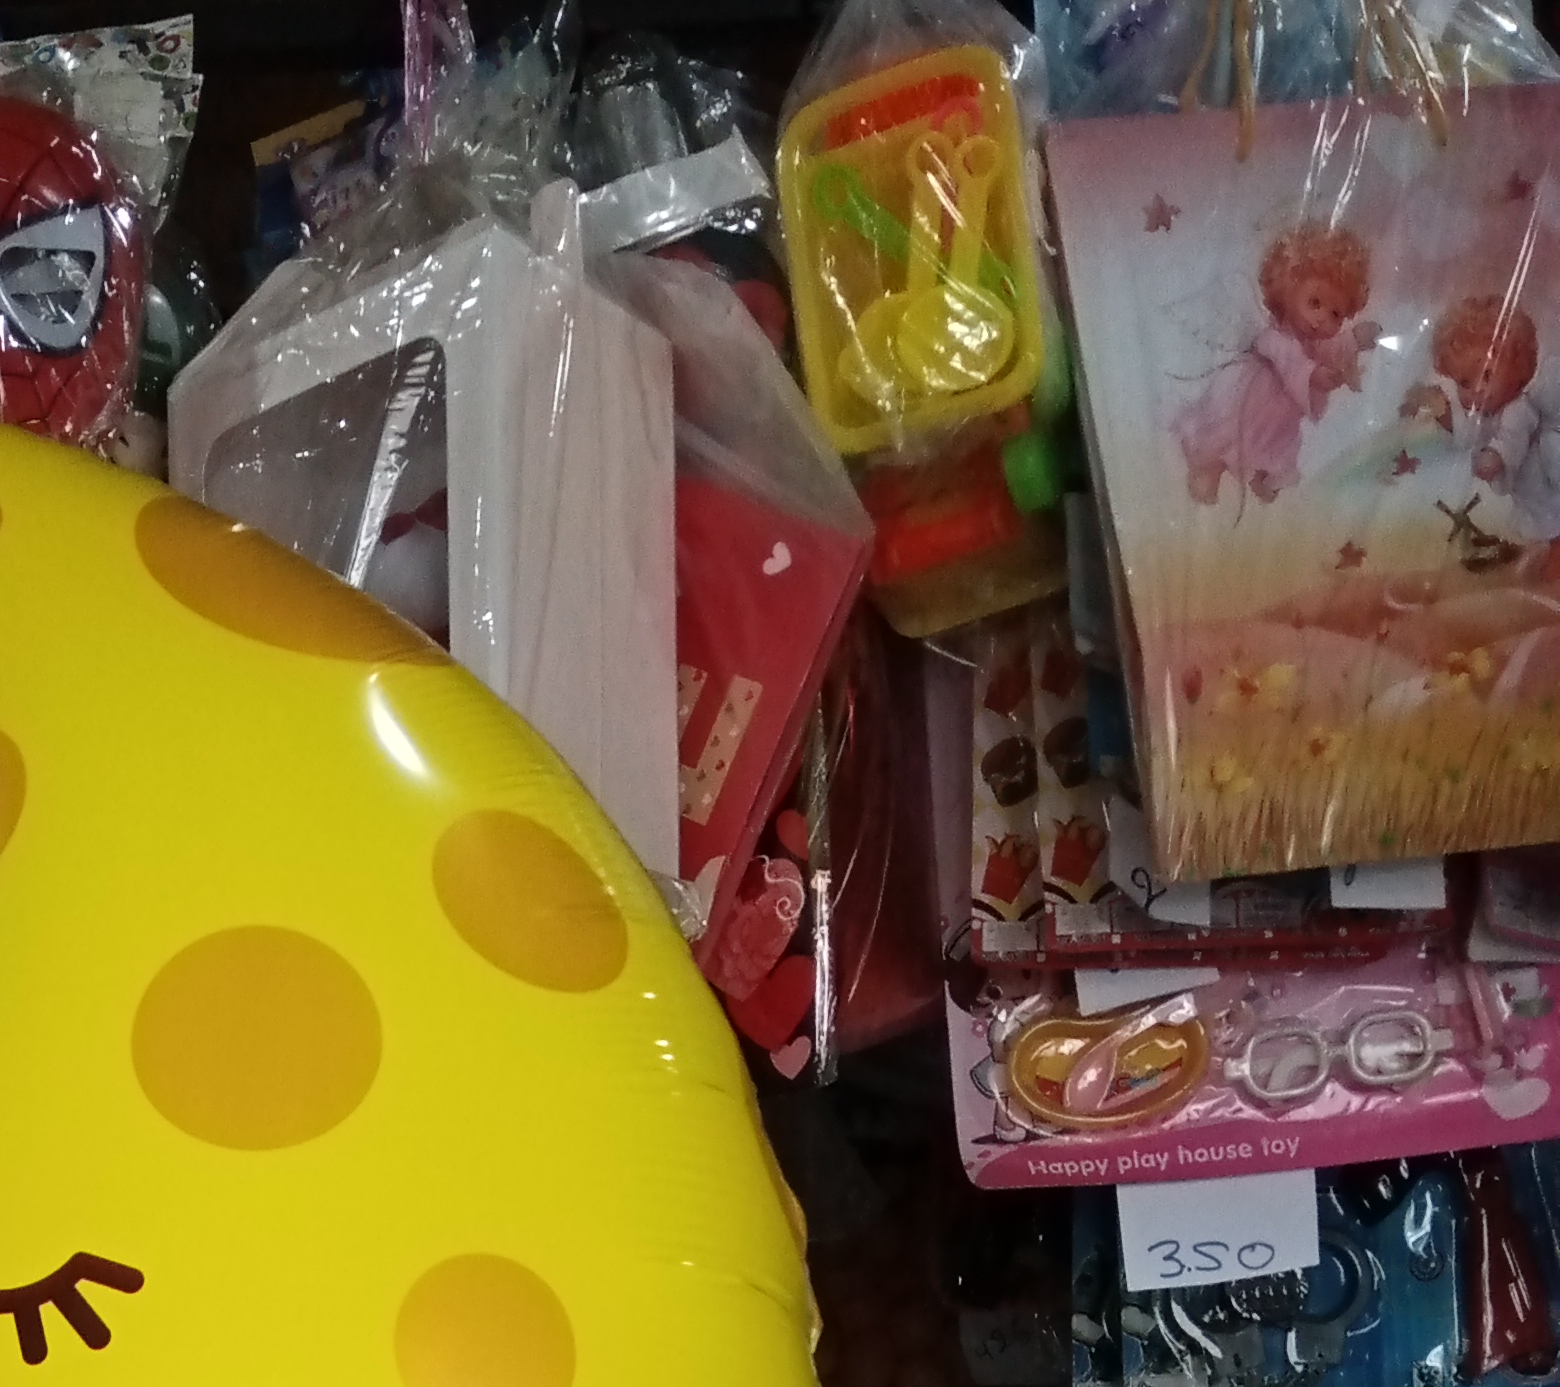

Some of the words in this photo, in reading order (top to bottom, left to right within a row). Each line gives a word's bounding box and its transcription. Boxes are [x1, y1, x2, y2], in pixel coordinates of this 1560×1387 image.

[1027, 1154, 1109, 1180] Happy
[1118, 1147, 1169, 1173] play
[1178, 1141, 1253, 1164] house
[1260, 1134, 1300, 1158] toy
[1148, 1239, 1277, 1279] 3.50
